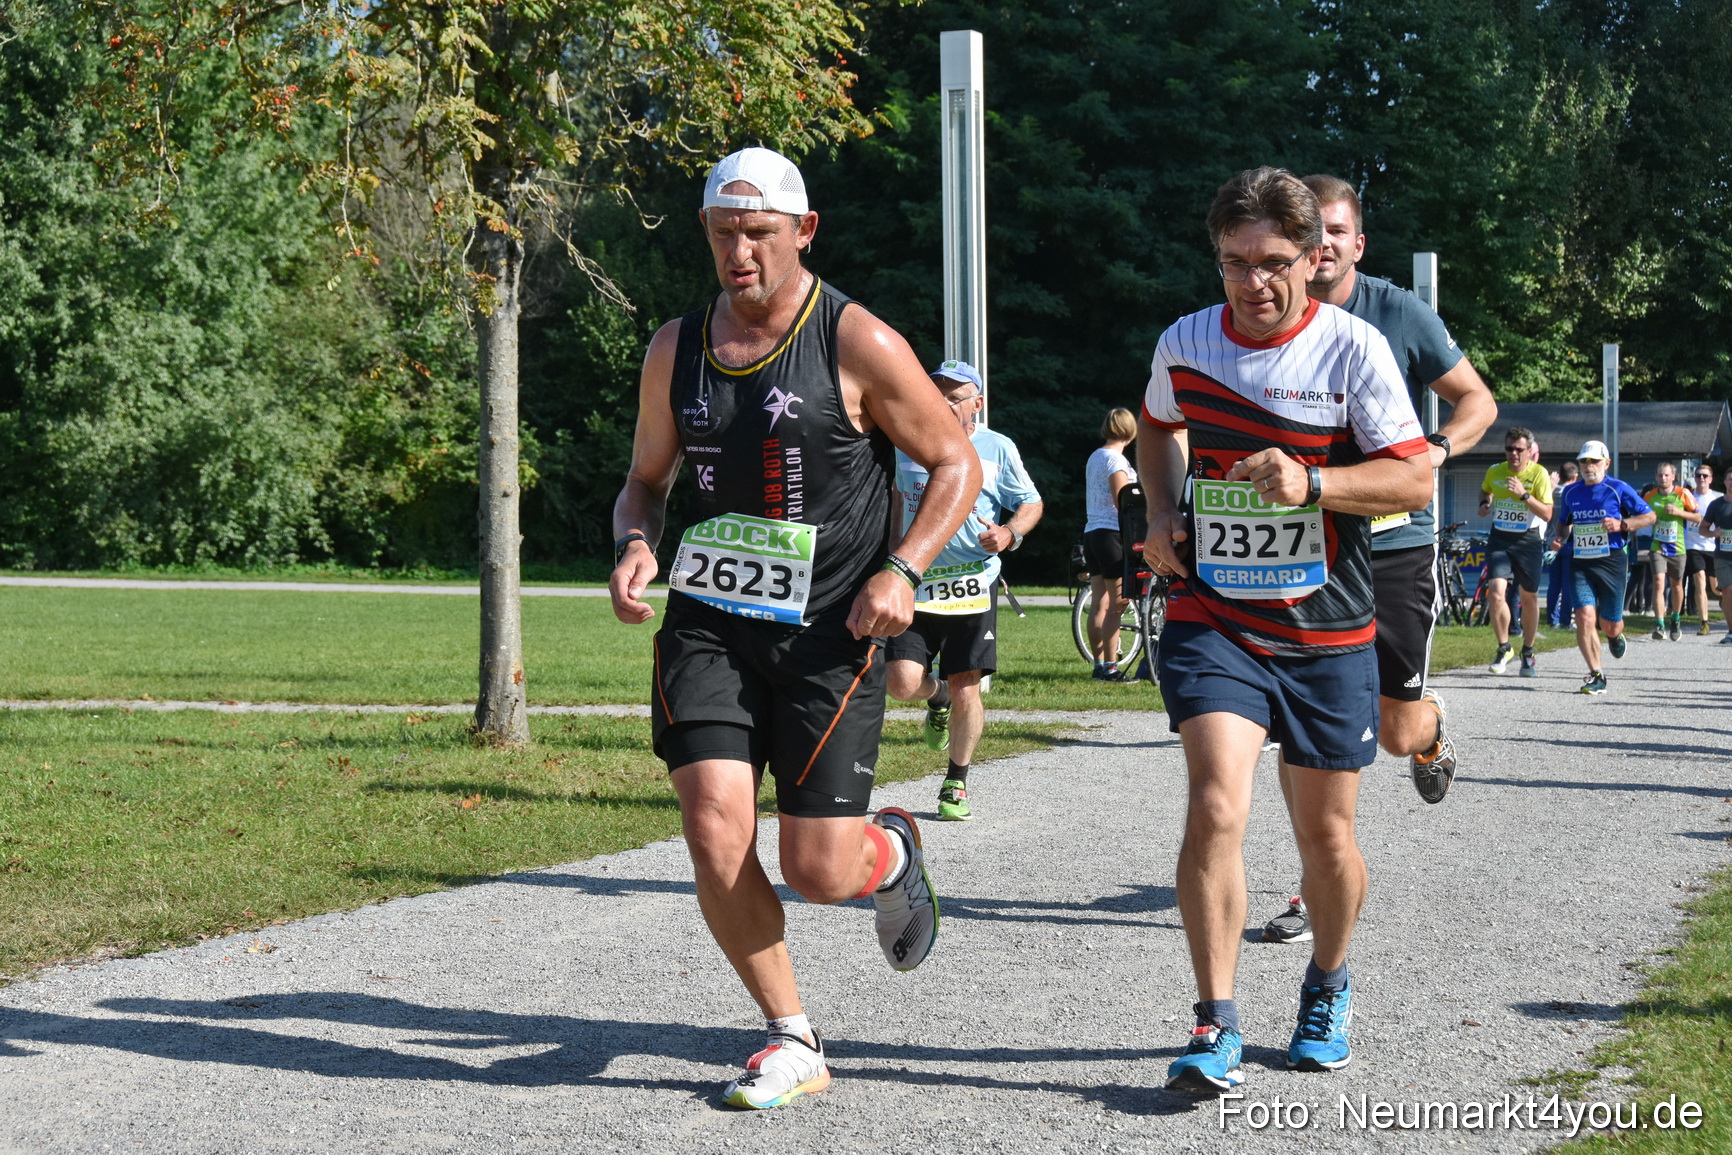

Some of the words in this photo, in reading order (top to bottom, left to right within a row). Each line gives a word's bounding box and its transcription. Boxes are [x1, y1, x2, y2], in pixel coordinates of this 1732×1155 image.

[1264, 387, 1332, 403] NEUMARKT
[762, 438, 782, 479] ROTH
[763, 483, 783, 503] 08
[785, 446, 804, 522] TRIATHLON
[1496, 510, 1524, 522] 2306
[1572, 509, 1607, 519] SYSCAD
[693, 518, 797, 553] BOCK
[1208, 521, 1306, 559] 2327
[1577, 535, 1603, 547] 2142
[685, 552, 793, 601] 2623
[1213, 568, 1307, 585] GERHARD
[924, 578, 981, 601] 1368
